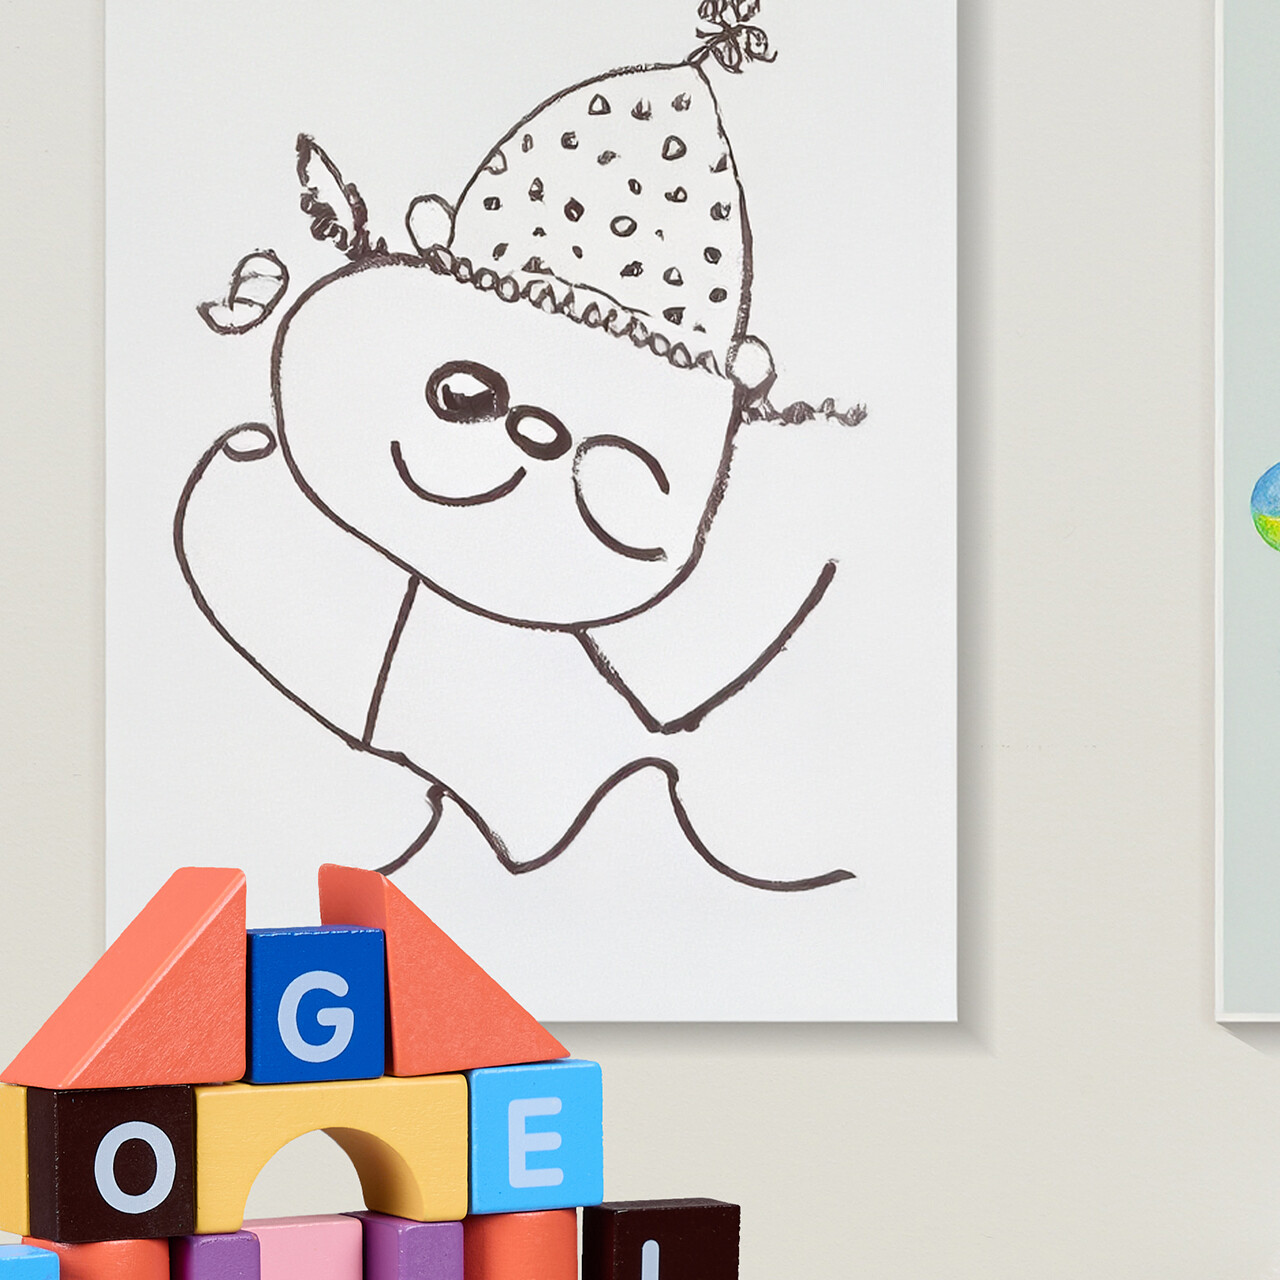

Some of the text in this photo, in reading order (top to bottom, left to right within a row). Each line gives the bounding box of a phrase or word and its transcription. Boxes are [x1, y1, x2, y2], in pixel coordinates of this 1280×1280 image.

[278, 971, 354, 1062] G
[95, 1121, 176, 1214] O
[508, 1097, 564, 1188] E
